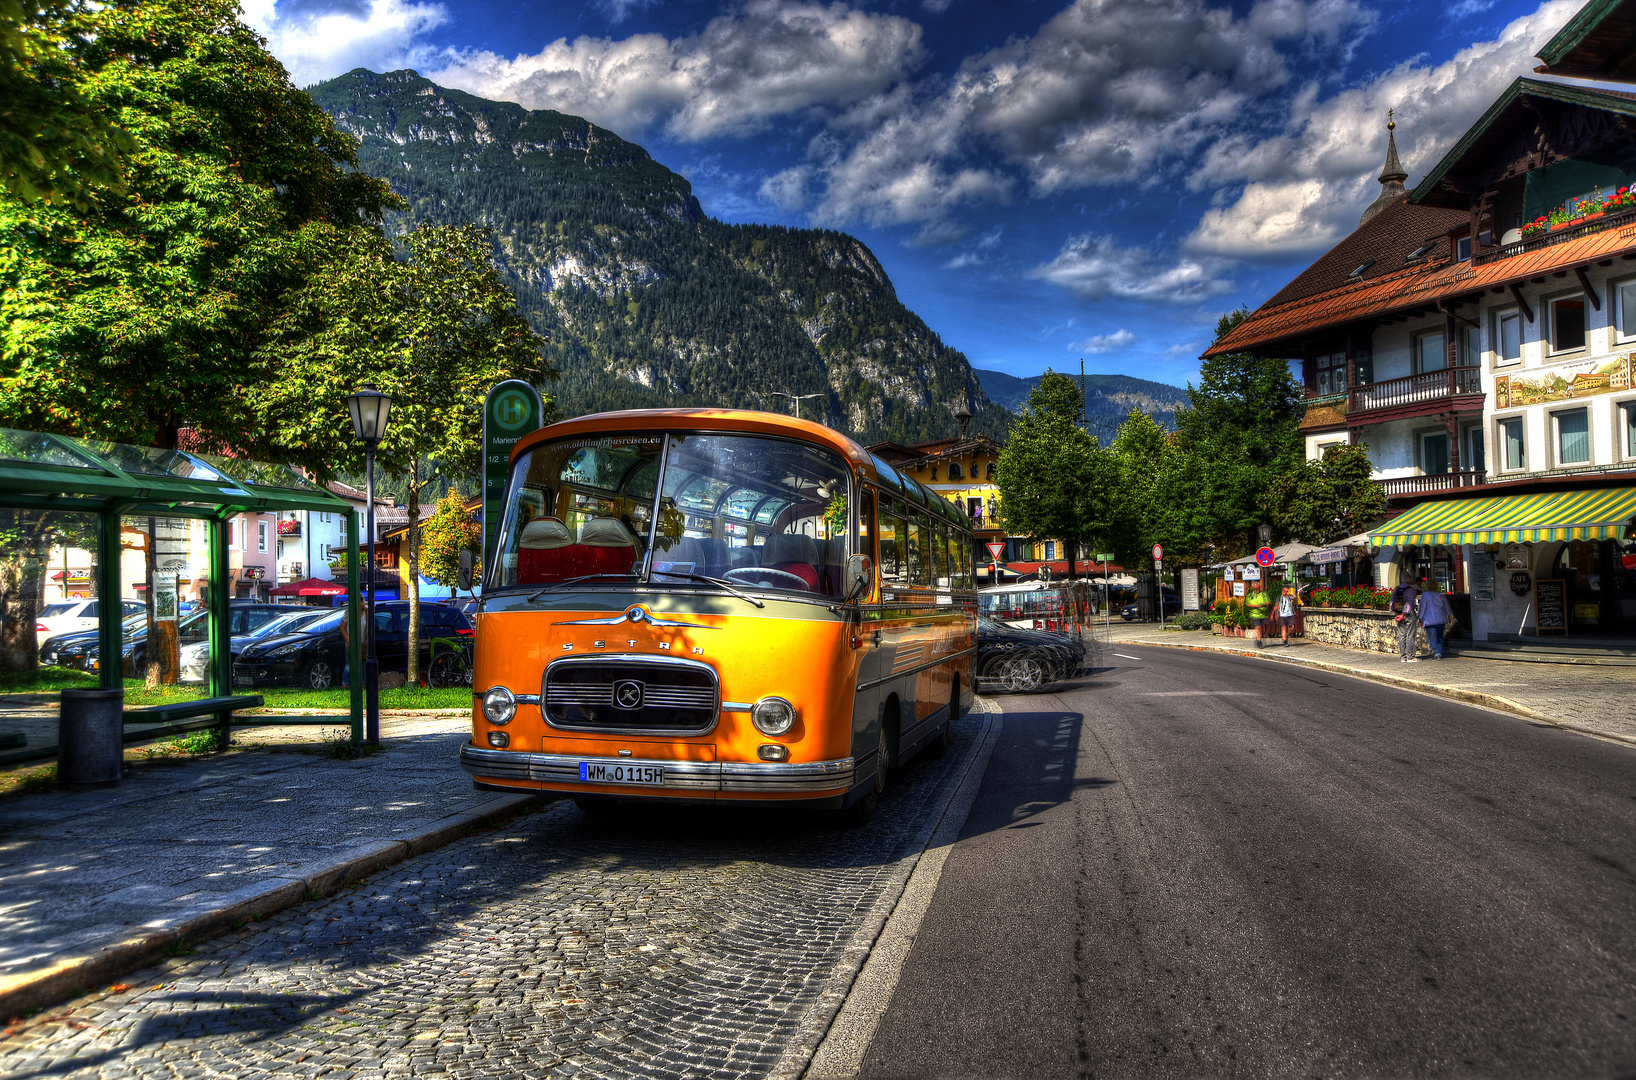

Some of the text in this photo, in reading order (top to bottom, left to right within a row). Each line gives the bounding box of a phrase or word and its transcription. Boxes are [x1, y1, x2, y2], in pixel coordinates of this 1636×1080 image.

[503, 399, 521, 421] H
[550, 436, 661, 451] www.oldtimerbusreisen.eu
[488, 455, 499, 463] 1/2
[487, 479, 493, 487] 5
[562, 639, 704, 655] SETRA
[587, 765, 606, 780] WM
[626, 768, 663, 783] 115H
